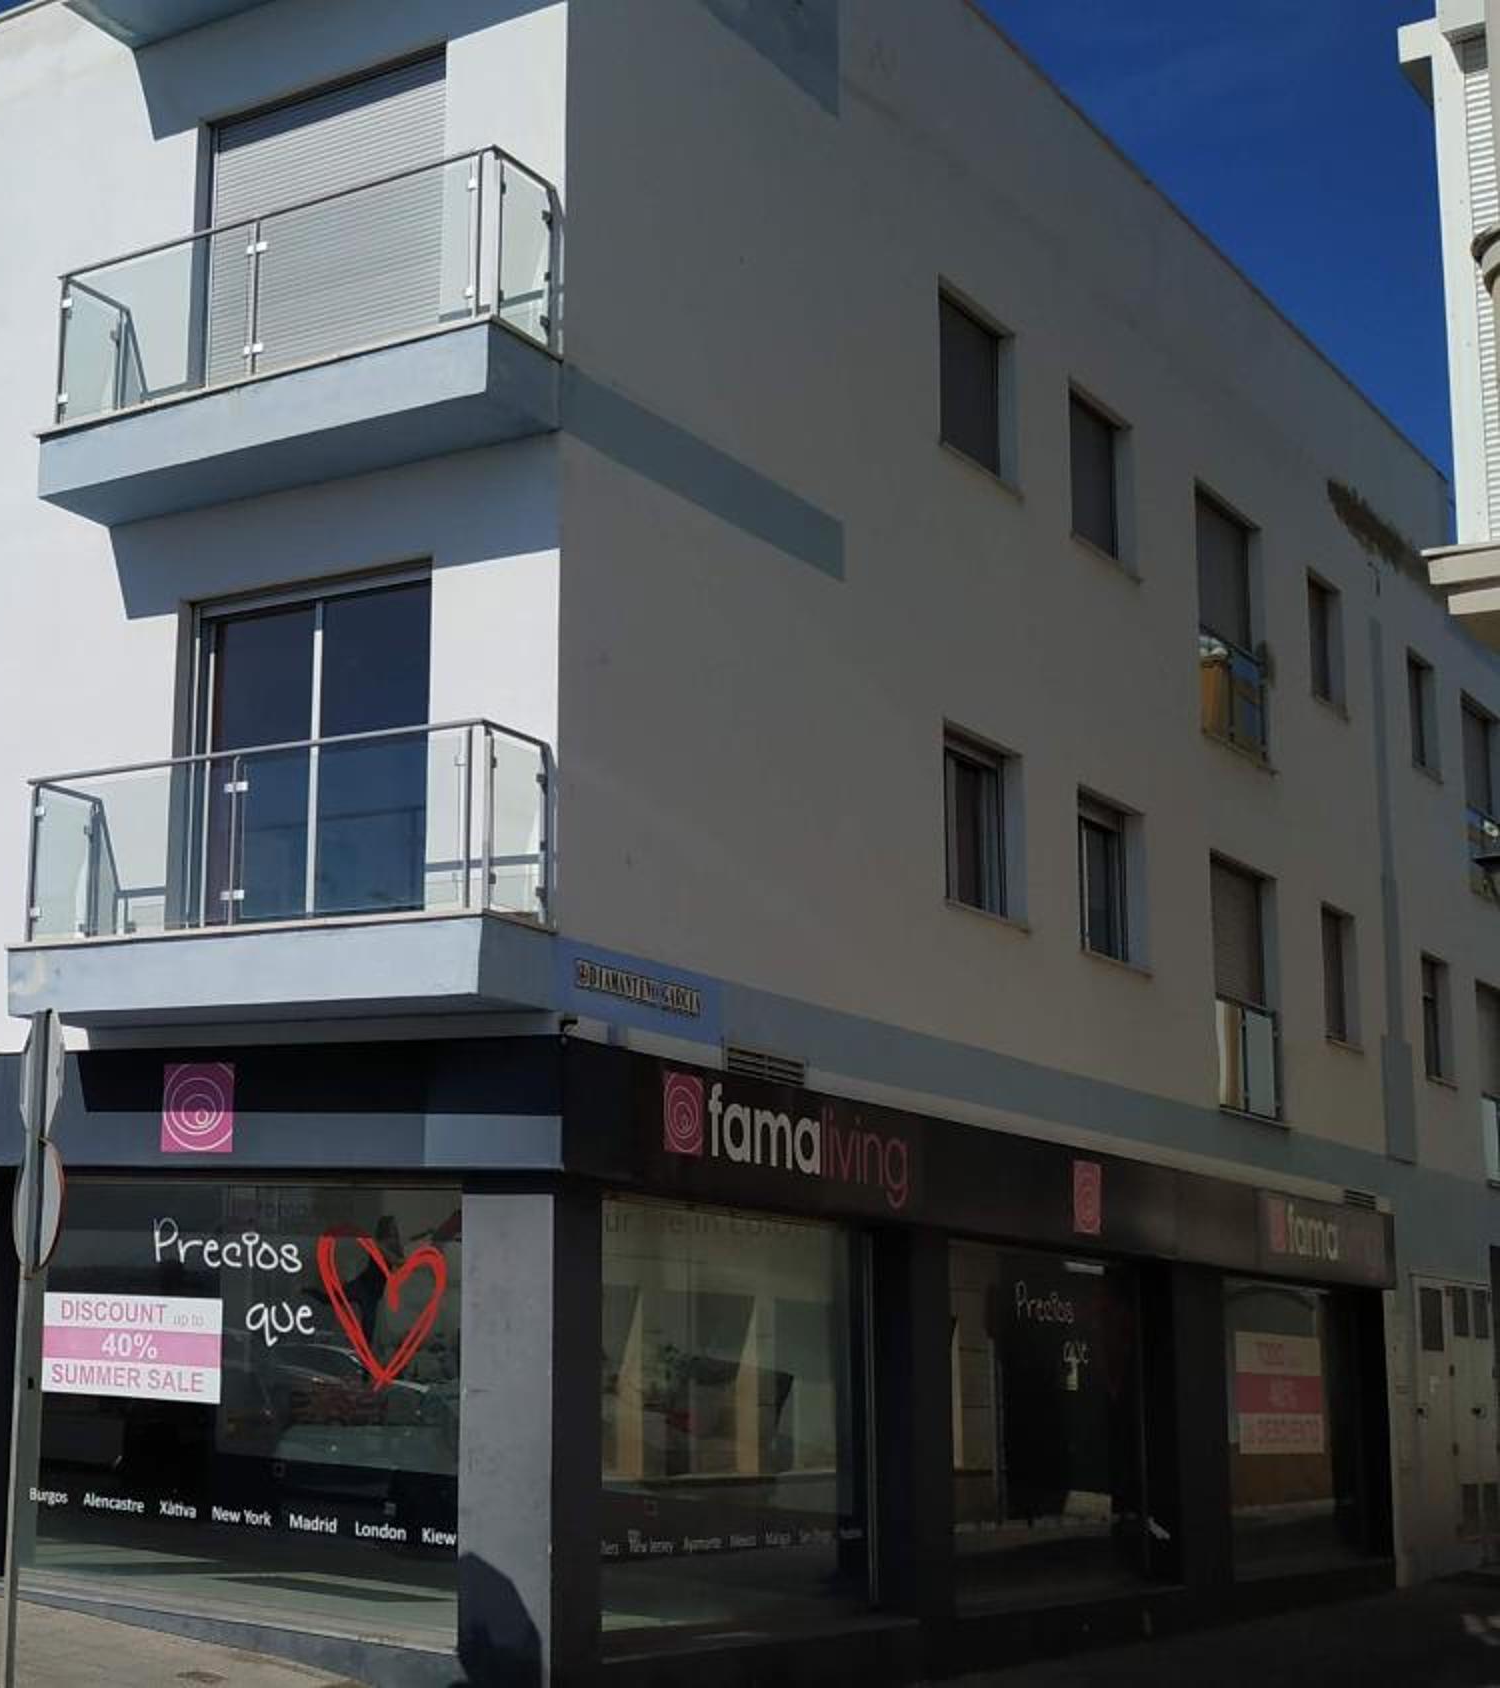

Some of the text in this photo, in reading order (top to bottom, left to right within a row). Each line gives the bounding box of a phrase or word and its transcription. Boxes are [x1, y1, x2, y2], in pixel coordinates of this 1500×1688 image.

[708, 1083, 909, 1208] famaliving
[153, 1217, 303, 1273] Precios
[61, 1300, 168, 1324] DISCOUNT
[245, 1300, 316, 1347] que
[100, 1332, 159, 1359] 40%
[51, 1363, 204, 1393] SUMMER SALE
[29, 1487, 69, 1506] Burgos
[83, 1491, 146, 1514] Alencastre
[212, 1505, 241, 1524] New
[242, 1508, 272, 1528] York
[288, 1513, 338, 1534] Madrid
[355, 1520, 407, 1542] London
[421, 1527, 458, 1548] Kiew
